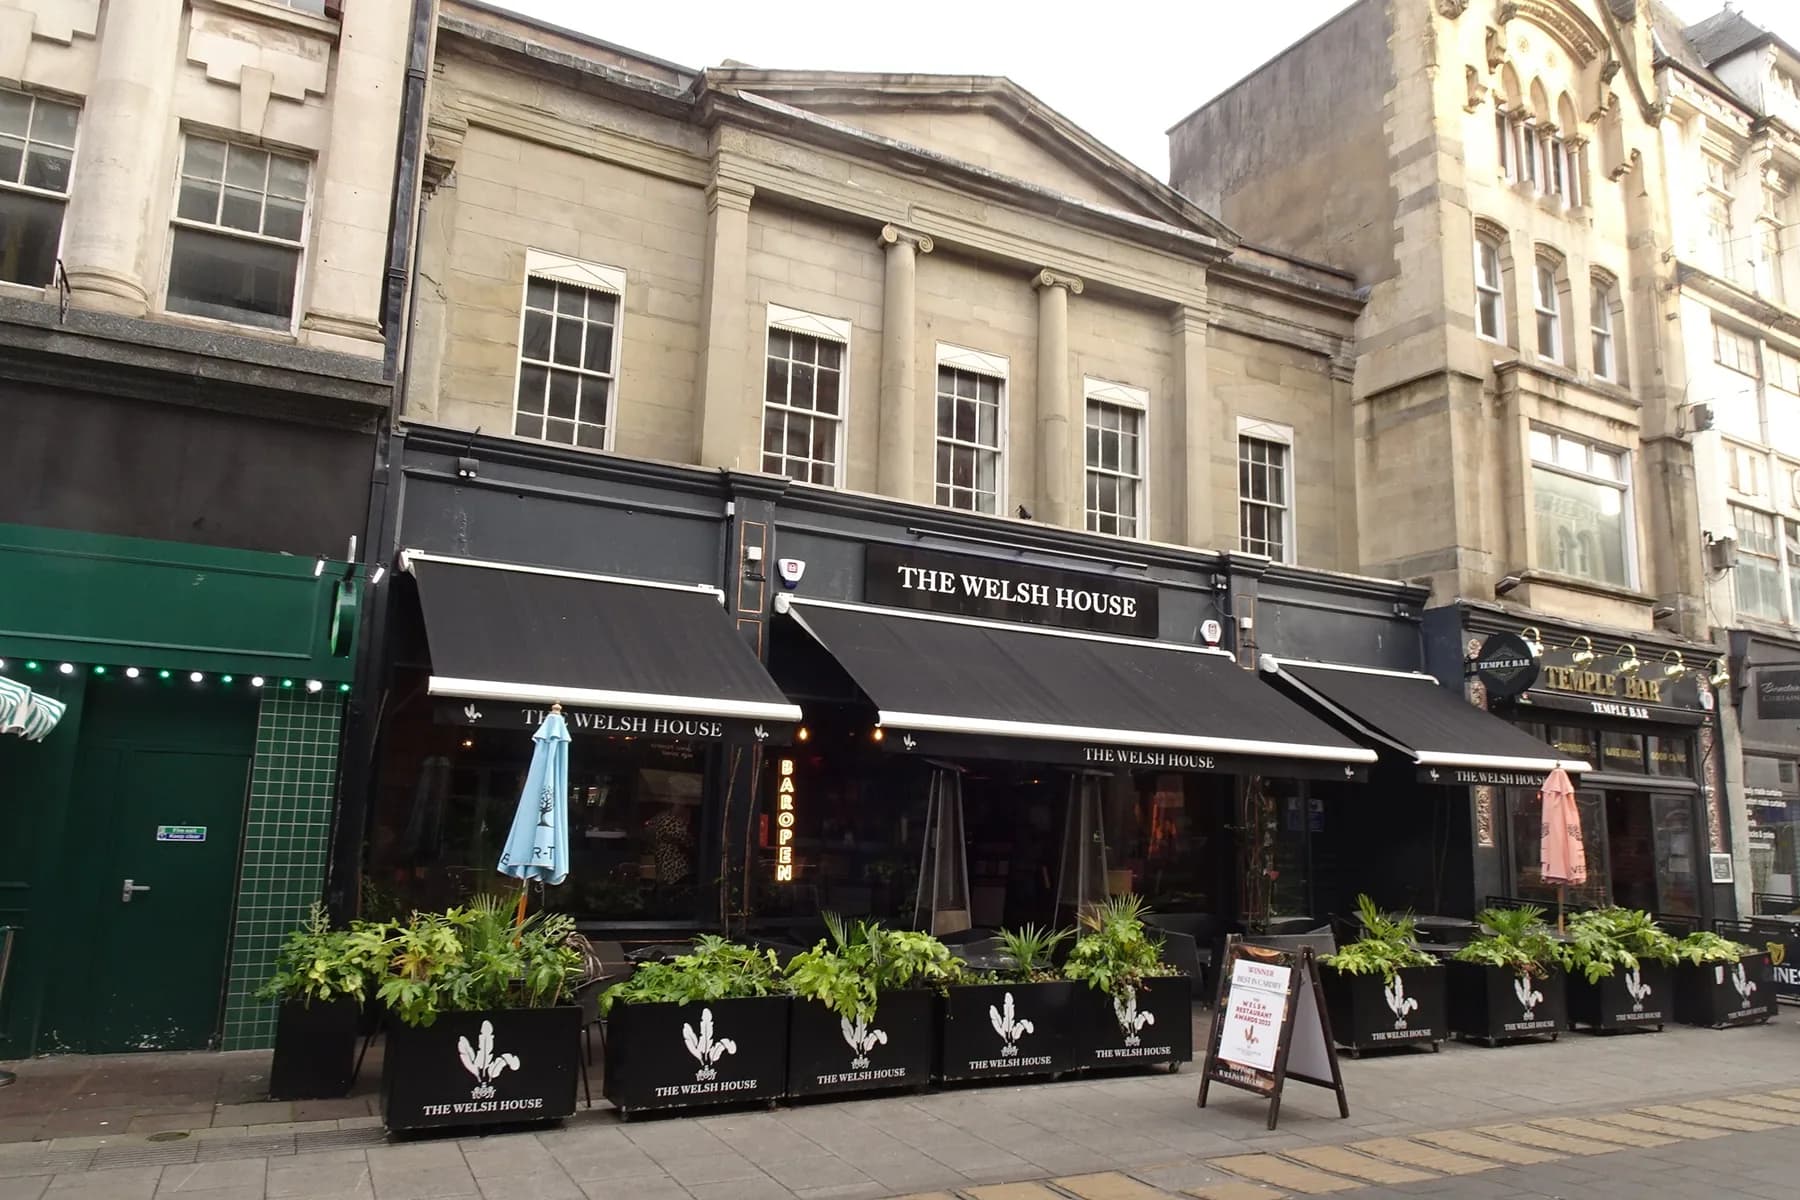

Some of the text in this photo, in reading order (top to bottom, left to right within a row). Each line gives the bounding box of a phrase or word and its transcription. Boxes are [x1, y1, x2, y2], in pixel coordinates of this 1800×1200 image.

[898, 566, 1137, 618] THE WELSH HOUSE
[1480, 659, 1530, 670] TEMPLE BAR
[1544, 665, 1661, 702] TEMPLE BAR
[1591, 701, 1649, 719] TEMPLE BAR
[574, 712, 647, 733] WELSH
[653, 718, 723, 737] HOUSE
[1083, 747, 1215, 769] THE WELSH HOUSE
[1455, 770, 1479, 783] THE
[1479, 772, 1513, 785] WELSH
[1235, 1005, 1273, 1019] RESTAURANT
[1242, 1000, 1267, 1010] WELSH
[1234, 1013, 1258, 1024] AWARDS
[1504, 1020, 1555, 1031] THE WELSH HOUSE
[1371, 1029, 1432, 1041] THE WELSH HOUSE
[1095, 1046, 1171, 1058] THE WELSH HOUSE
[968, 1056, 1052, 1070] THE WELSH HOUSE
[816, 1067, 906, 1085] THE WELSH HOUSE
[655, 1079, 757, 1097] THE WELSH HOUSE
[423, 1098, 543, 1116] THE WELSH HOUSE
